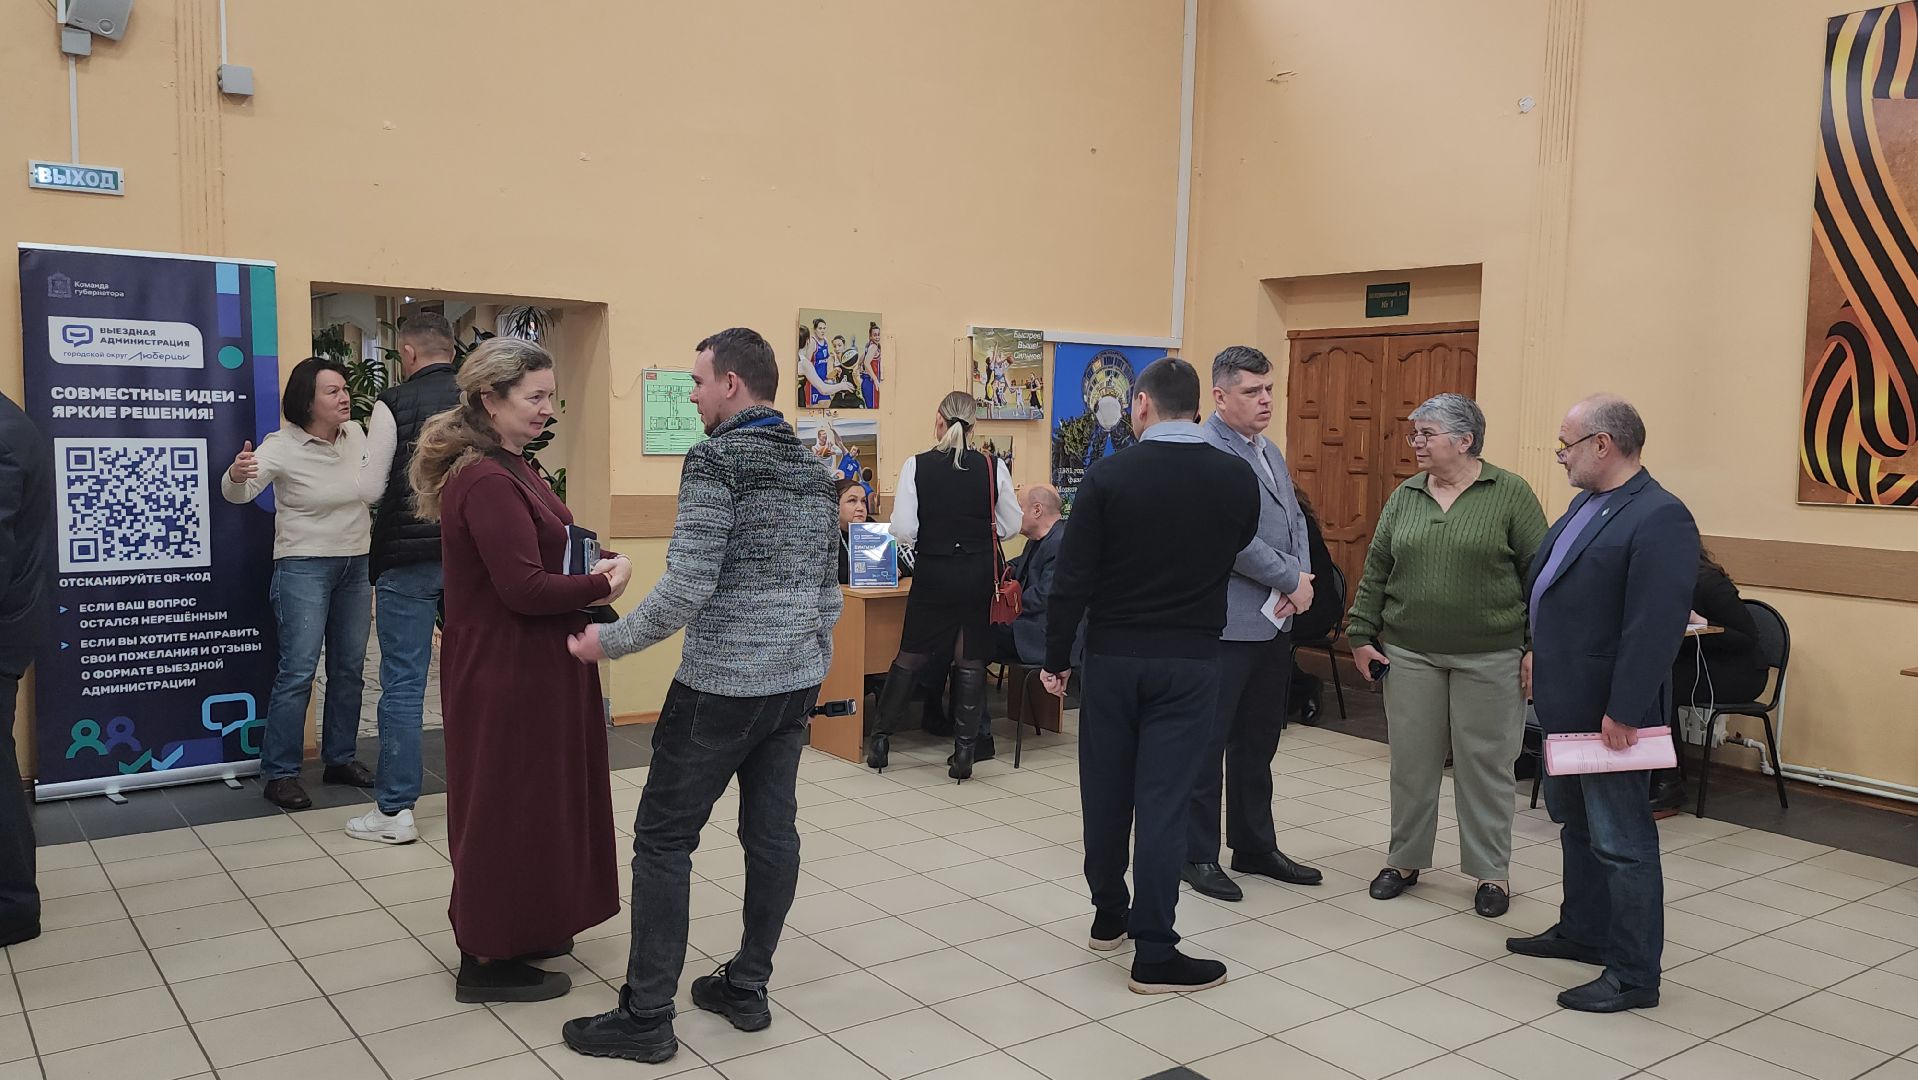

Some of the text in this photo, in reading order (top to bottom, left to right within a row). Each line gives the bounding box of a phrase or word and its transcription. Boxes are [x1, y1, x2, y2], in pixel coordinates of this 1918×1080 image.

[37, 166, 116, 190] ВЫХОД
[74, 280, 109, 290] Команда
[74, 289, 125, 298] губернатора
[100, 327, 156, 337] ВЫЕЗДНАЯ
[100, 336, 190, 348] АДМИНИСТРАЦИЯ
[63, 352, 105, 360] городской
[128, 352, 191, 362] Люберцы
[51, 386, 182, 402] СОВМЕСТНЫЕ
[185, 390, 235, 404] ИДЕИ
[52, 406, 214, 420] ЯРКИЕ РЕШЕНИЯ!
[59, 572, 211, 588] ОТСКАНИРУЙТЕ QR-КОД
[79, 598, 197, 613] ЕСЛИ ВАШ ВОПРОС
[80, 610, 228, 629] ОСТАЛСЯ НЕРЕШЁННЫМ
[80, 627, 260, 649] ЕСЛИ ВЫ ХОТИТЕ НАПРАВИТЬ
[80, 642, 262, 664] СВОИ ПОЖЕЛАНИЯ И ОТЗЫВЫ
[81, 658, 224, 681] О ФОРМАТЕ ВЫЕЗДНОЙ
[82, 678, 196, 696] АДМИНИСТРАЦИИ
